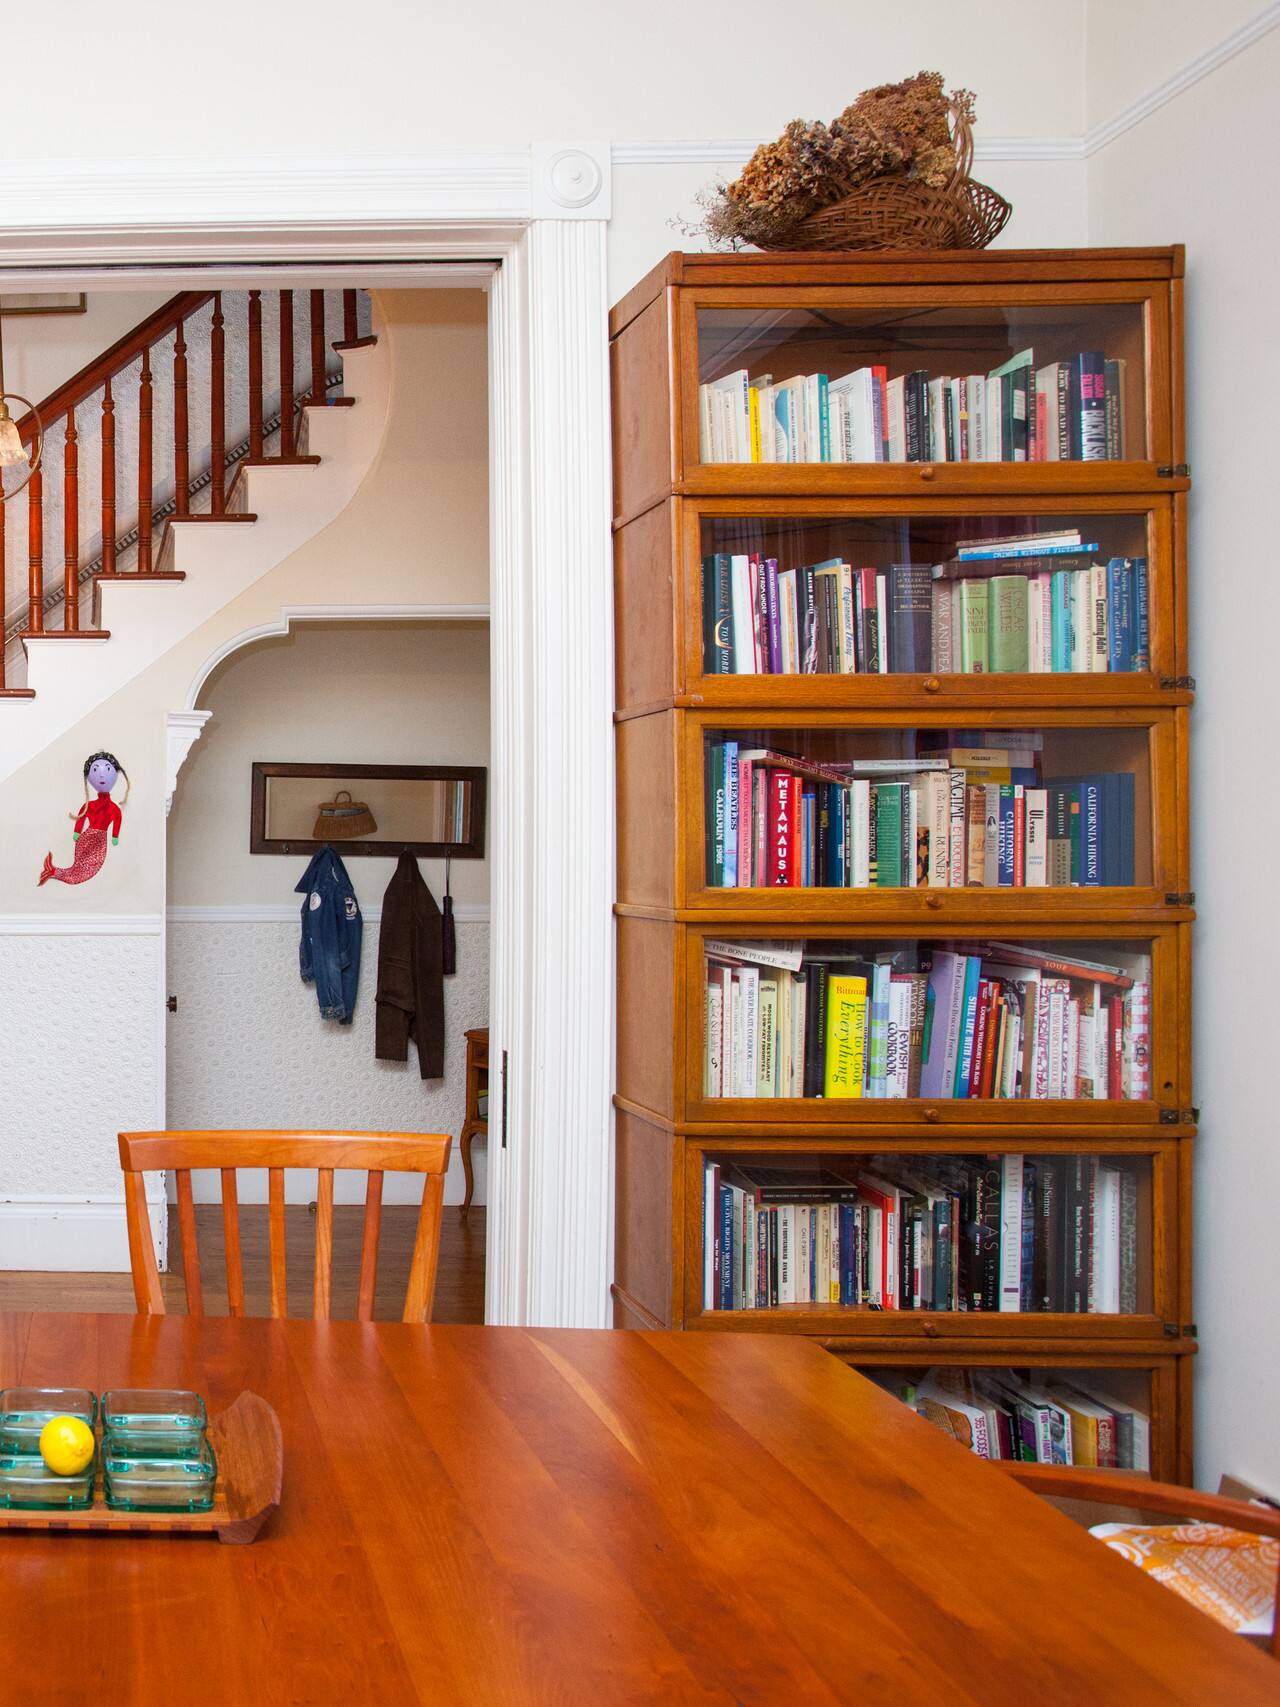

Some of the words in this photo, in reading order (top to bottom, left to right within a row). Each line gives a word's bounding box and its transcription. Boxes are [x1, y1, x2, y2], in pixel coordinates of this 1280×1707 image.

[1081, 410, 1105, 461] BACKLASH
[939, 592, 949, 618] WAR
[1000, 591, 1012, 633] WILDE
[1013, 590, 1024, 633] OSCAR
[1093, 599, 1106, 636] Consenting
[939, 623, 949, 648] AND
[1096, 636, 1106, 655] Adult
[716, 789, 724, 840] CALHOUN
[950, 772, 964, 823] RAGTIME
[1087, 787, 1096, 842] CALIFORNIA
[777, 779, 788, 870] METAMAUS
[1006, 811, 1014, 873] CALIFORNIA
[936, 836, 945, 879] RUNNER
[1088, 844, 1096, 878] HIKING
[918, 979, 926, 1026] MARGARET
[832, 1001, 855, 1085] Everything
[886, 1022, 897, 1077] COOKBOOK
[852, 1053, 863, 1085] Cook
[984, 1170, 999, 1251] CALLAS
[1044, 1190, 1052, 1217] Simon
[975, 1429, 989, 1452] FOODS
